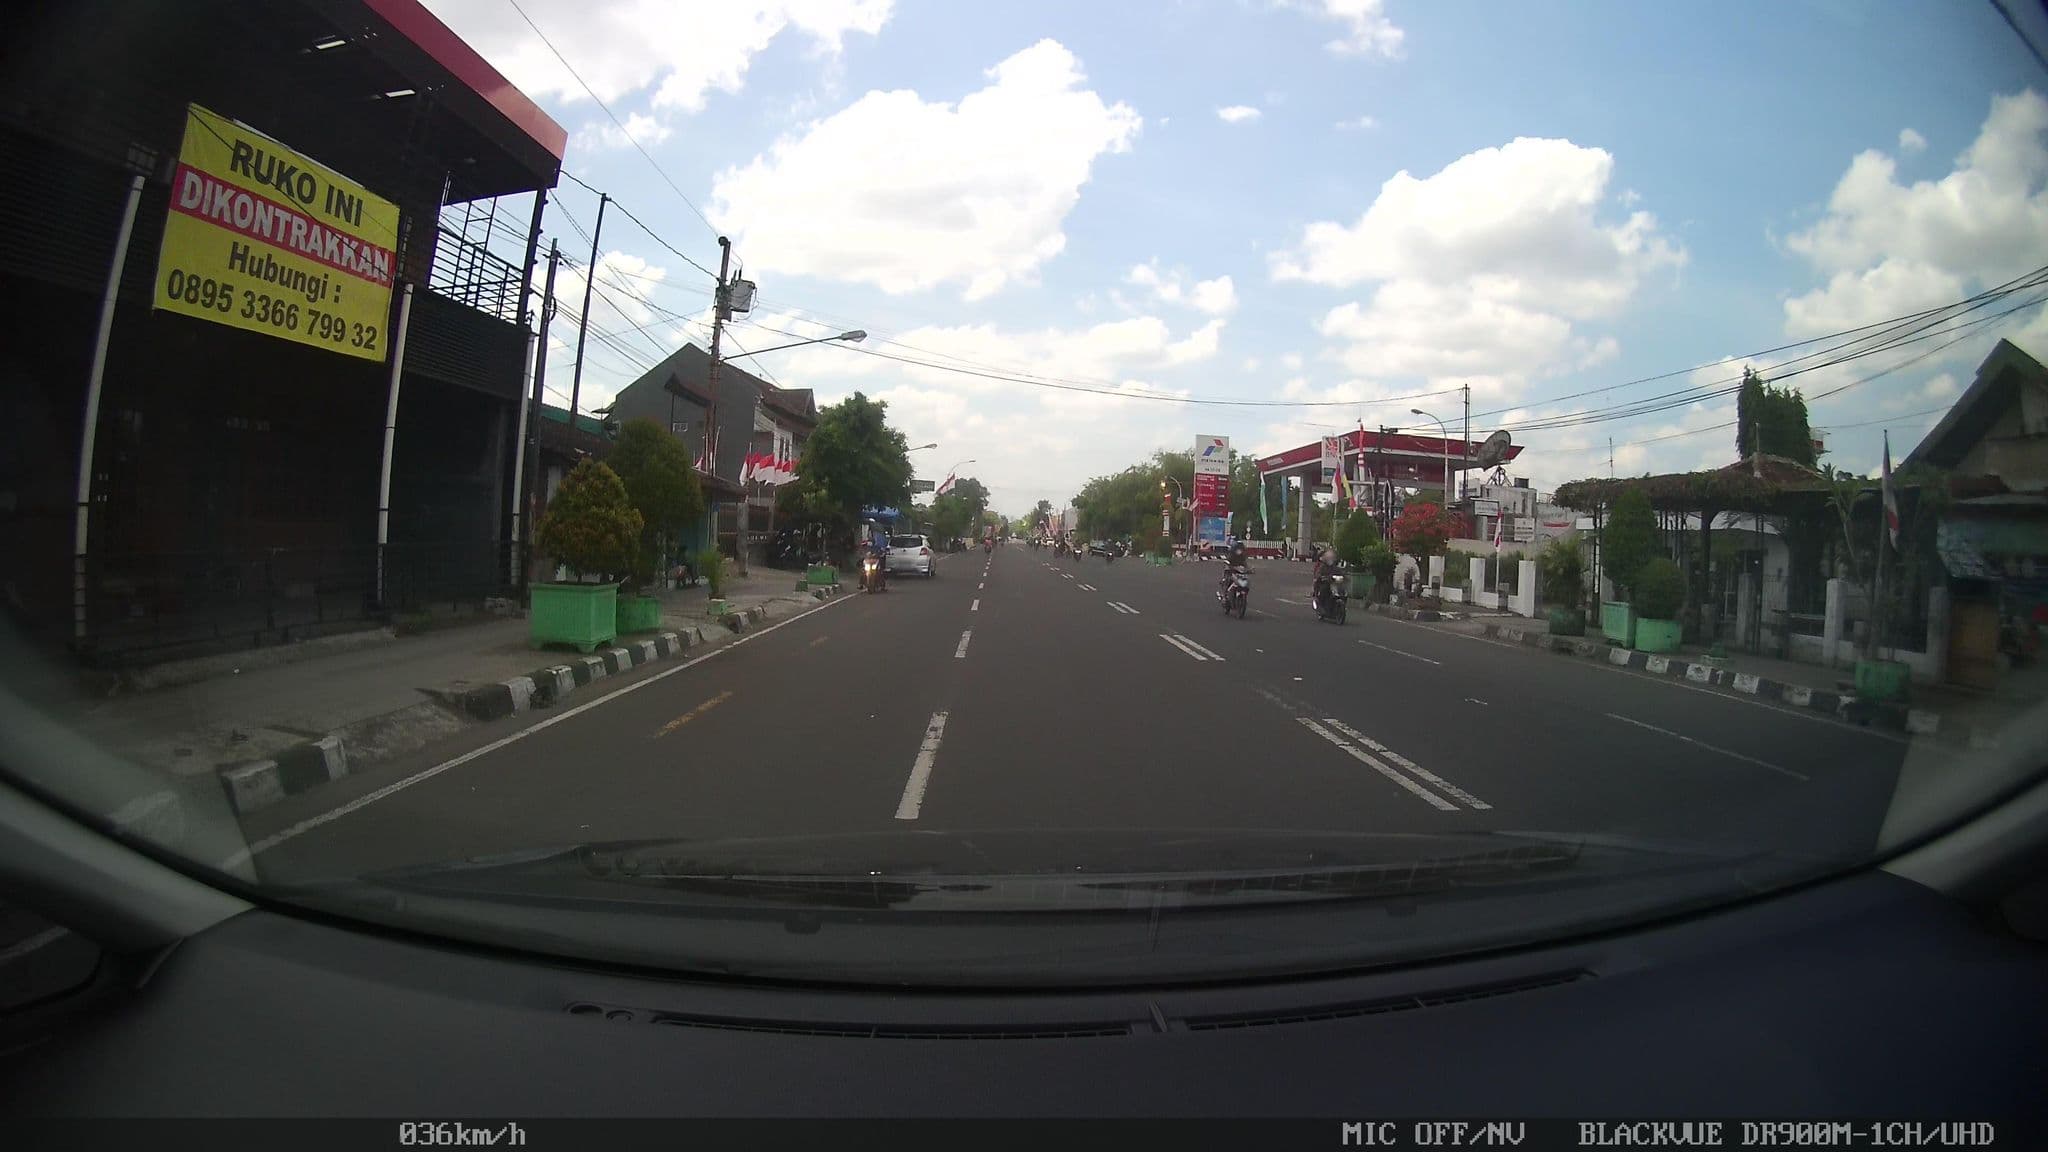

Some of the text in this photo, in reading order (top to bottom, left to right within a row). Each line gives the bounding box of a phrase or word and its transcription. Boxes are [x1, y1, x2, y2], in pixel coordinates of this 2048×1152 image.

[230, 139, 364, 227] RUKO INI
[180, 171, 389, 281] DIKONTRAKKAN
[167, 268, 378, 351] 0895 3366 799 32
[228, 241, 329, 303] Hubungi
